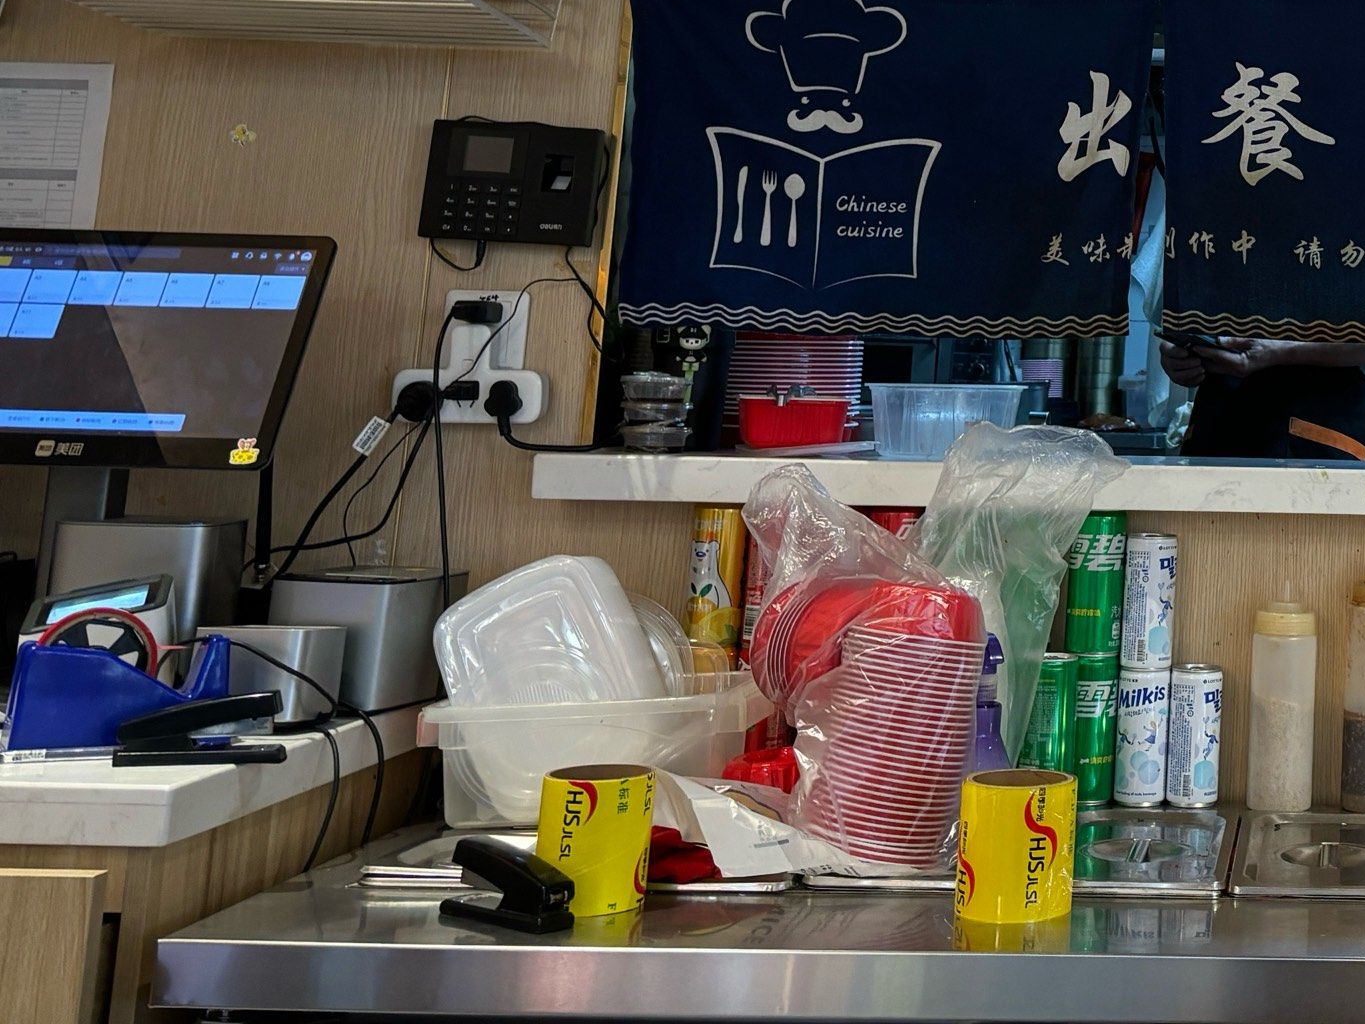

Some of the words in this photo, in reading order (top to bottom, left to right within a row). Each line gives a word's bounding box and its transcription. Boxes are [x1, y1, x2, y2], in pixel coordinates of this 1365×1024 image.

[836, 195, 908, 215] Chinese
[837, 219, 904, 239] cuisine
[54, 442, 85, 456] 美团
[1119, 685, 1166, 709] Milkis
